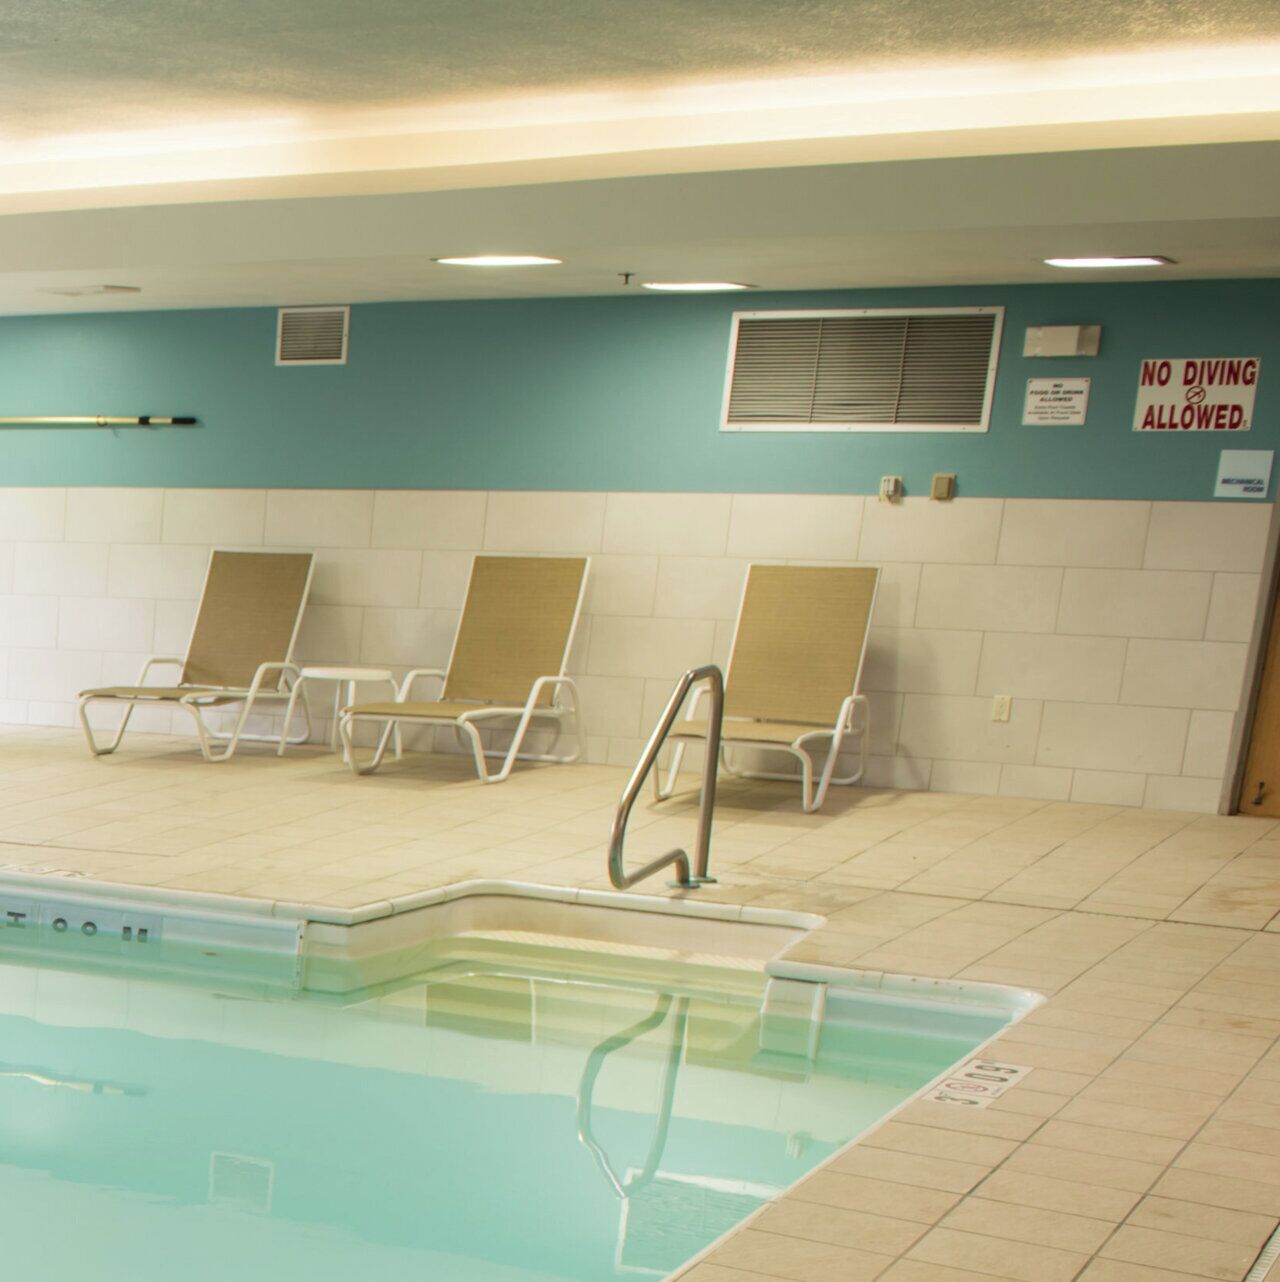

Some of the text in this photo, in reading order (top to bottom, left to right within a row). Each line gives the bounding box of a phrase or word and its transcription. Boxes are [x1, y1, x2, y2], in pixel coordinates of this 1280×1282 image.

[1141, 359, 1257, 386] NO DIVING
[1141, 403, 1243, 429] ALLOWED
